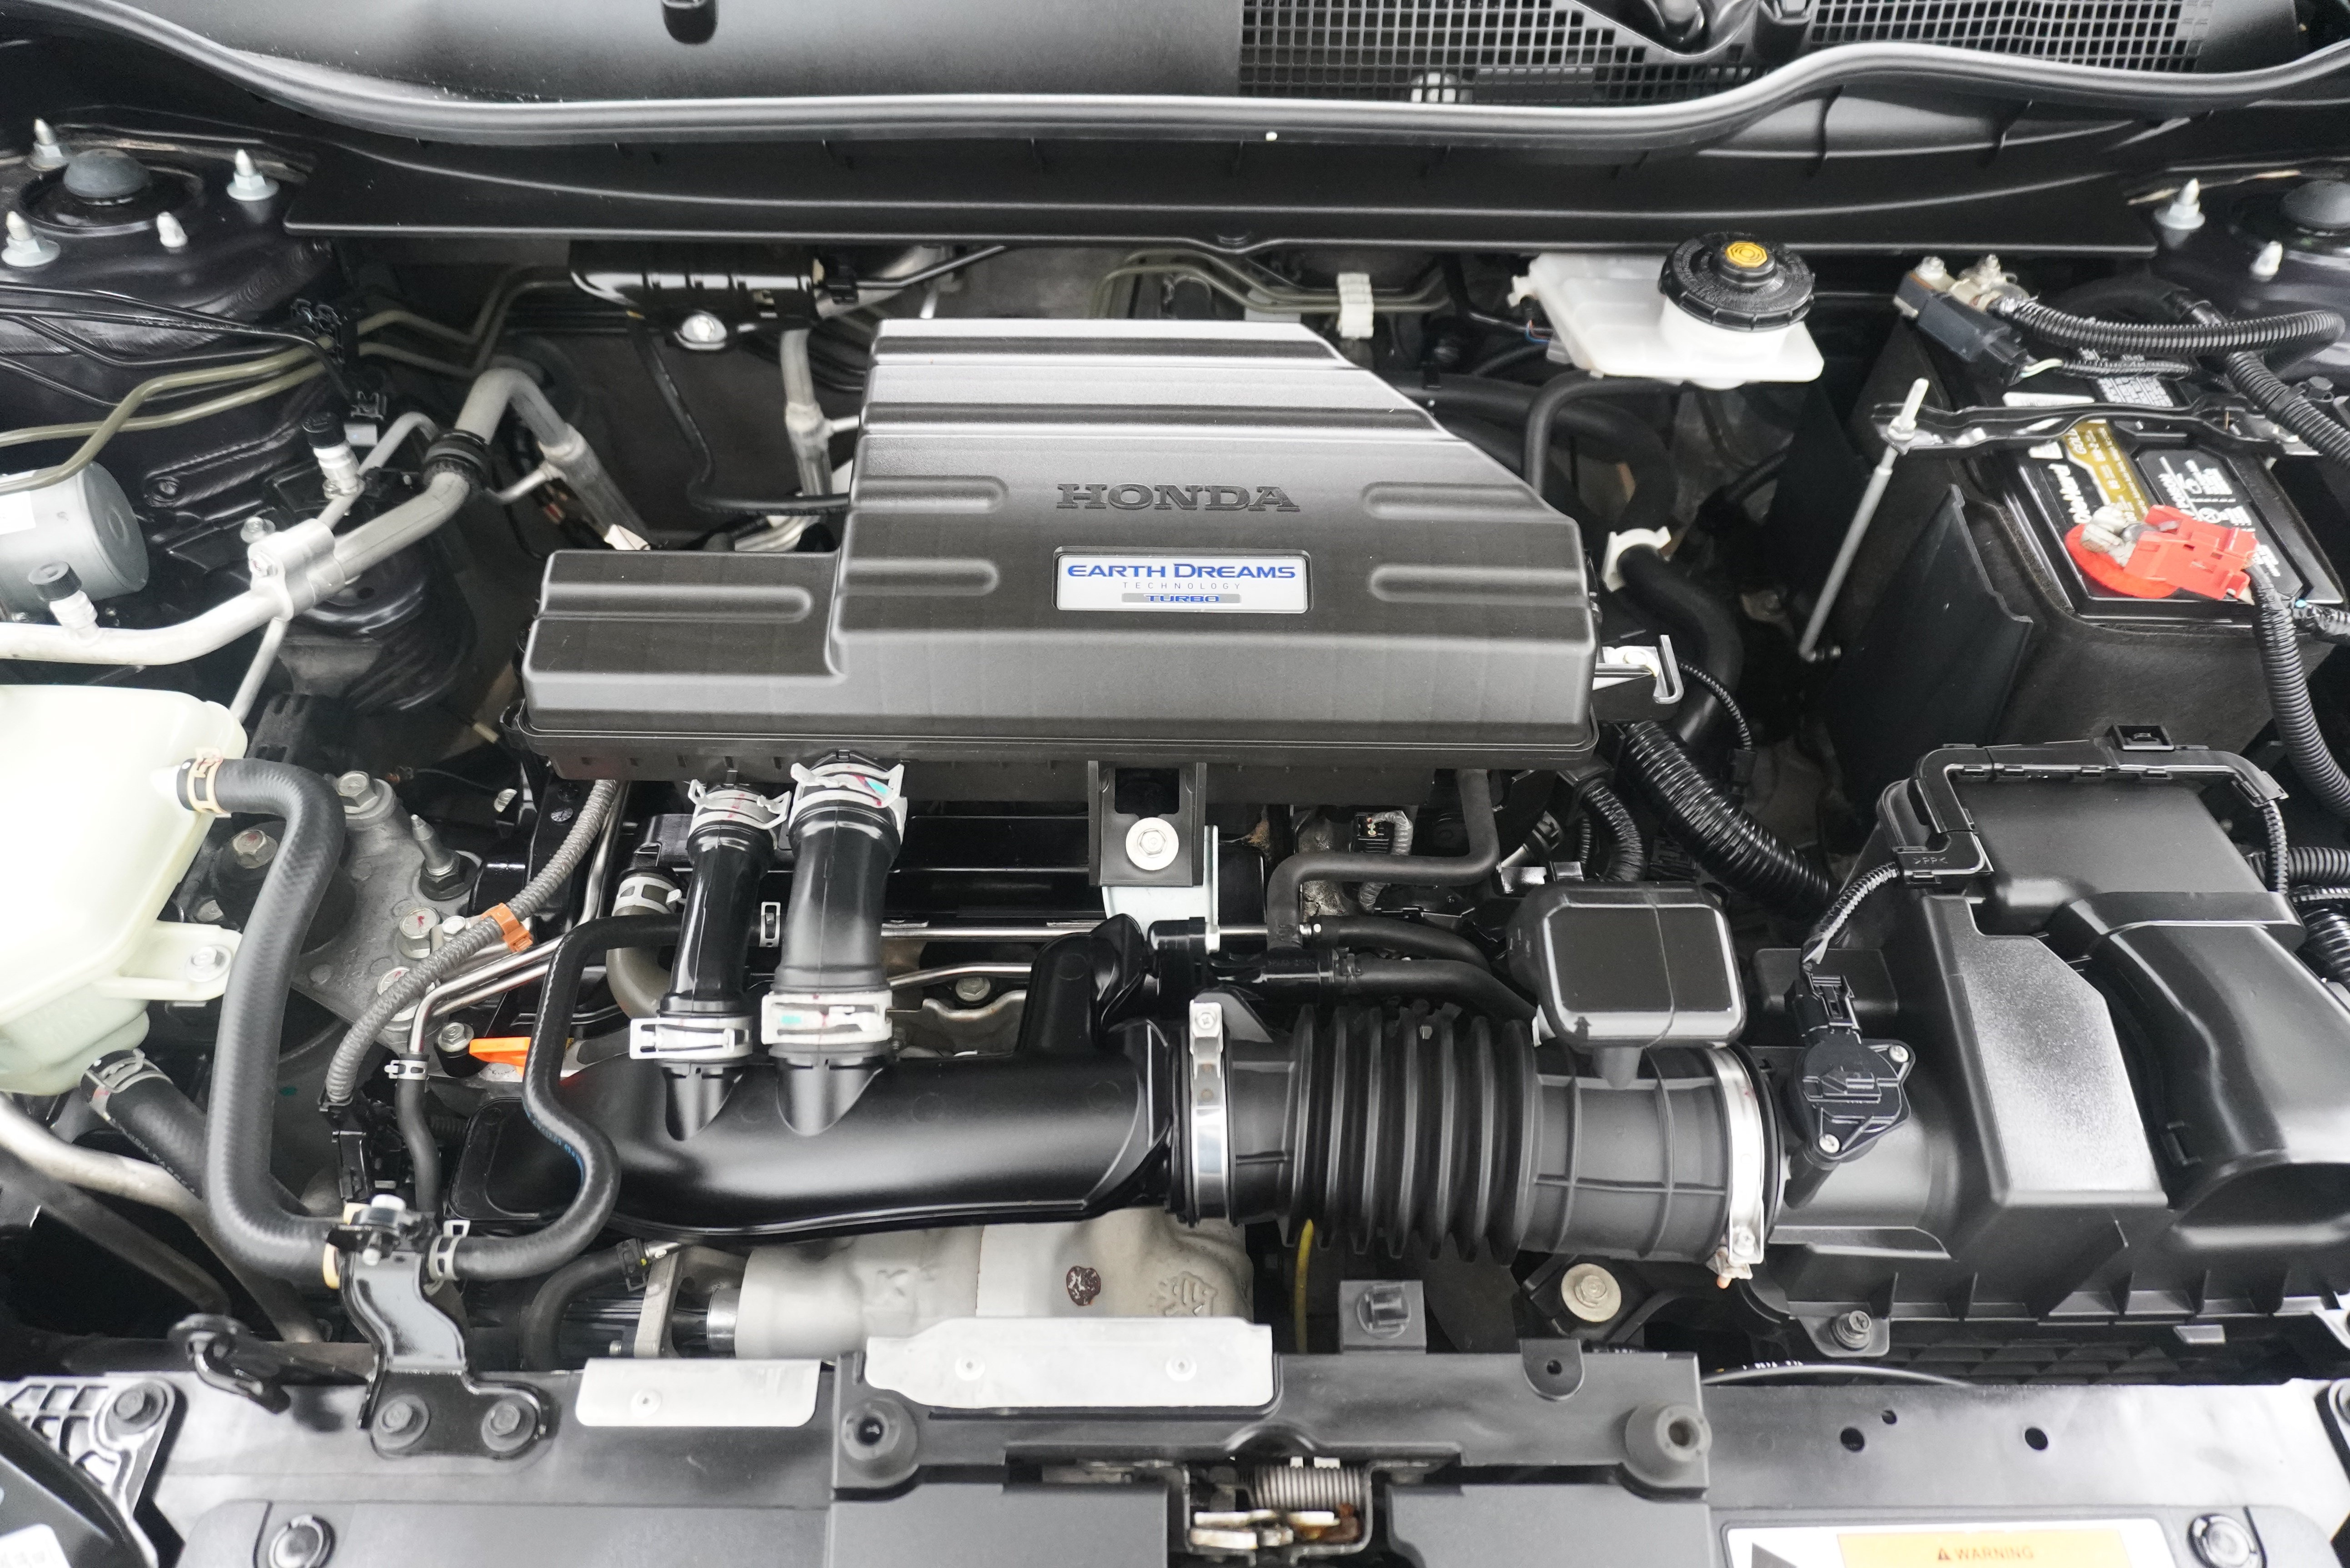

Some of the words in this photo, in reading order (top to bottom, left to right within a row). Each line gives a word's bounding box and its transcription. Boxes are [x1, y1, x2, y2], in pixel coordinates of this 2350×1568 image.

[1056, 483, 1301, 512] HONDA
[2048, 463, 2092, 523] DieHard
[2158, 473, 2190, 508] POISON
[1068, 564, 1166, 578] EARTH
[1172, 563, 1296, 579] DREAMS
[1123, 582, 1241, 590] TECHNOLOGY
[1144, 594, 1220, 603] TURBO
[1954, 1546, 2034, 1560] WARNING
